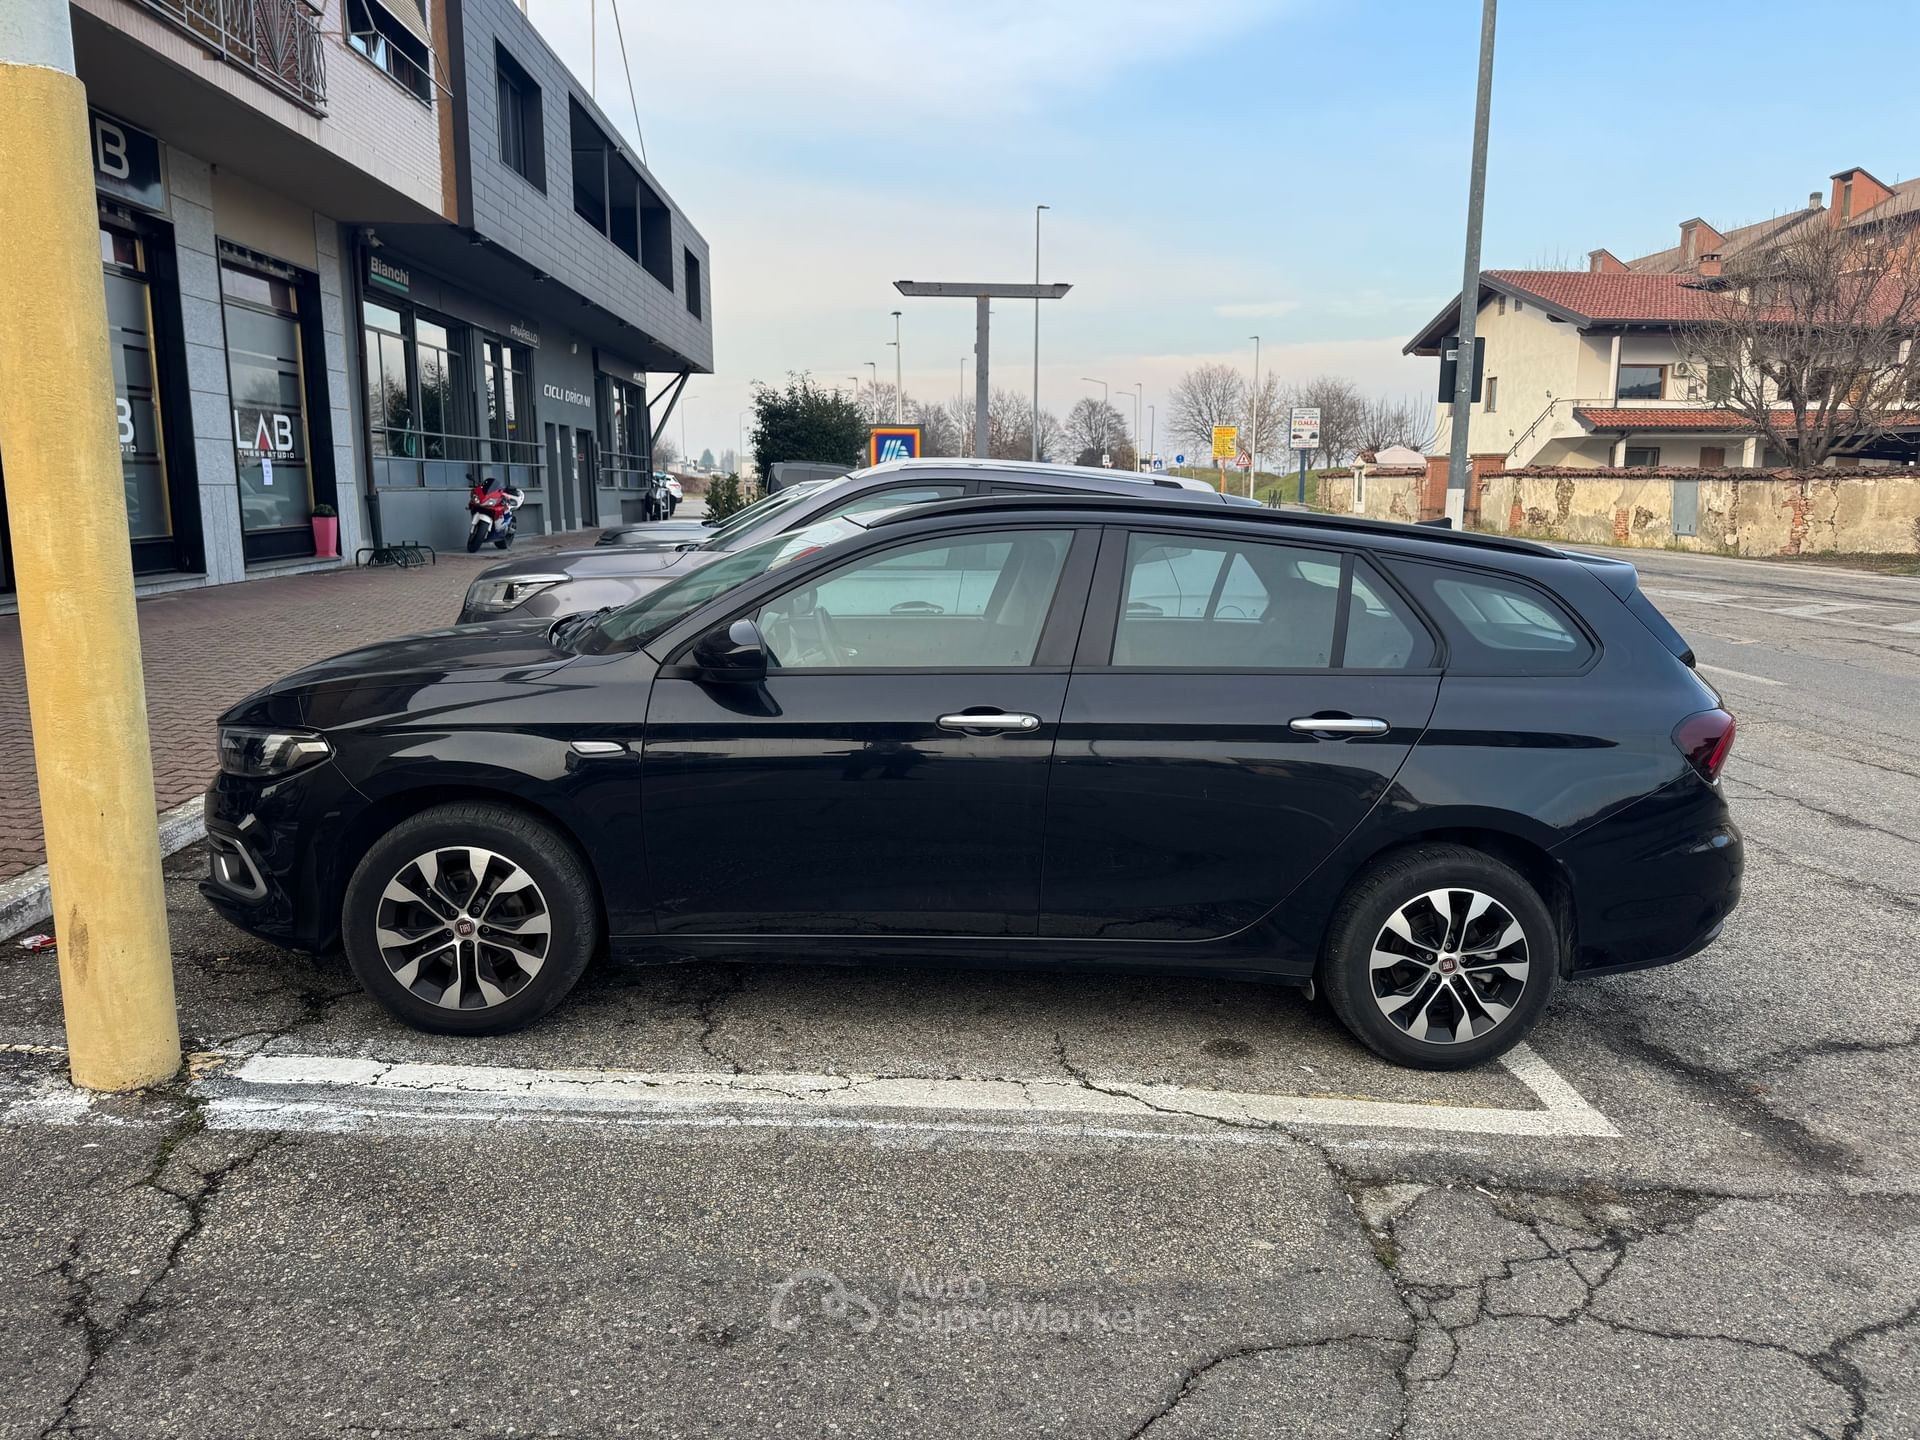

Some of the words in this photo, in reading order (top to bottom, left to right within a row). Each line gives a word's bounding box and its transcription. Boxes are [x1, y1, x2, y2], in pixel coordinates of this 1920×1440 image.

[371, 256, 409, 285] Bianchi
[543, 384, 563, 400] CICLI
[234, 409, 293, 451] LAB
[267, 451, 295, 459] STUDIO
[459, 923, 471, 934] FIAT
